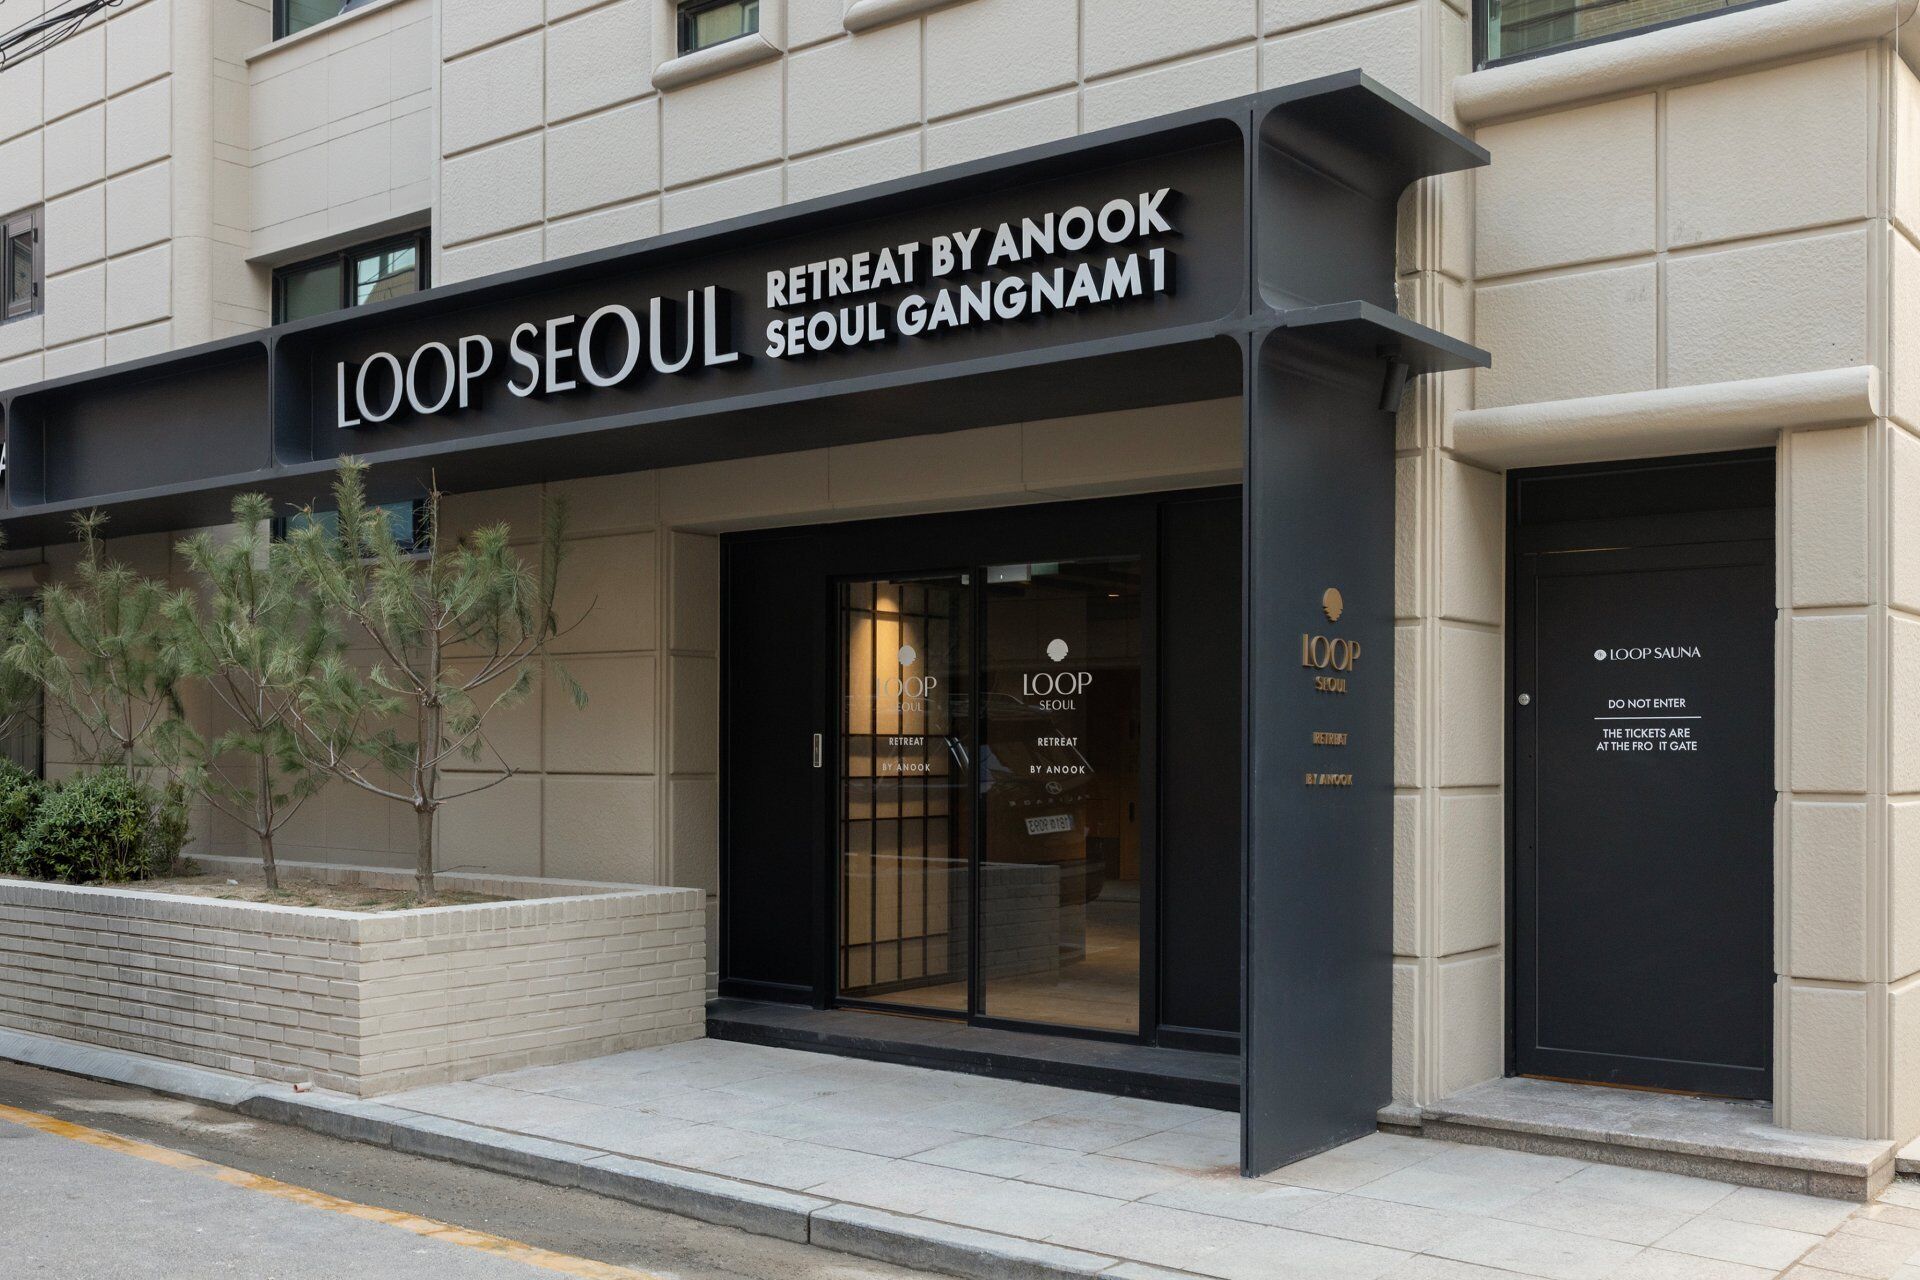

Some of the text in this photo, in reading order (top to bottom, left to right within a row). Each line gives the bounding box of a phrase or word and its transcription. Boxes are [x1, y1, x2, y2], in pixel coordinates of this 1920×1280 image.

[766, 187, 1172, 309] RETREAT BY ANOOK
[765, 304, 886, 359] SEOUL
[337, 285, 739, 428] LOOP SEOUL
[1302, 633, 1361, 672] LOOP
[1610, 646, 1701, 660] LOOP SAUNA
[1023, 671, 1093, 696] LOOP
[1315, 676, 1348, 693] SEOUL
[890, 701, 924, 712] EOUL
[1039, 699, 1076, 711] SEOUL
[1608, 698, 1686, 709] DO NOT ENTER
[1312, 731, 1348, 745] RETREAT
[1602, 728, 1691, 739] THE TICKETS ARE
[888, 737, 925, 747] RETREAT
[1037, 737, 1078, 748] RETREAT
[1596, 741, 1609, 751] AT
[1611, 741, 1630, 751] THE
[1670, 741, 1698, 751] GATE
[882, 763, 931, 772] BY ANOOK
[1030, 765, 1085, 774] BY ANOOK
[1319, 773, 1353, 786] ANOOK
